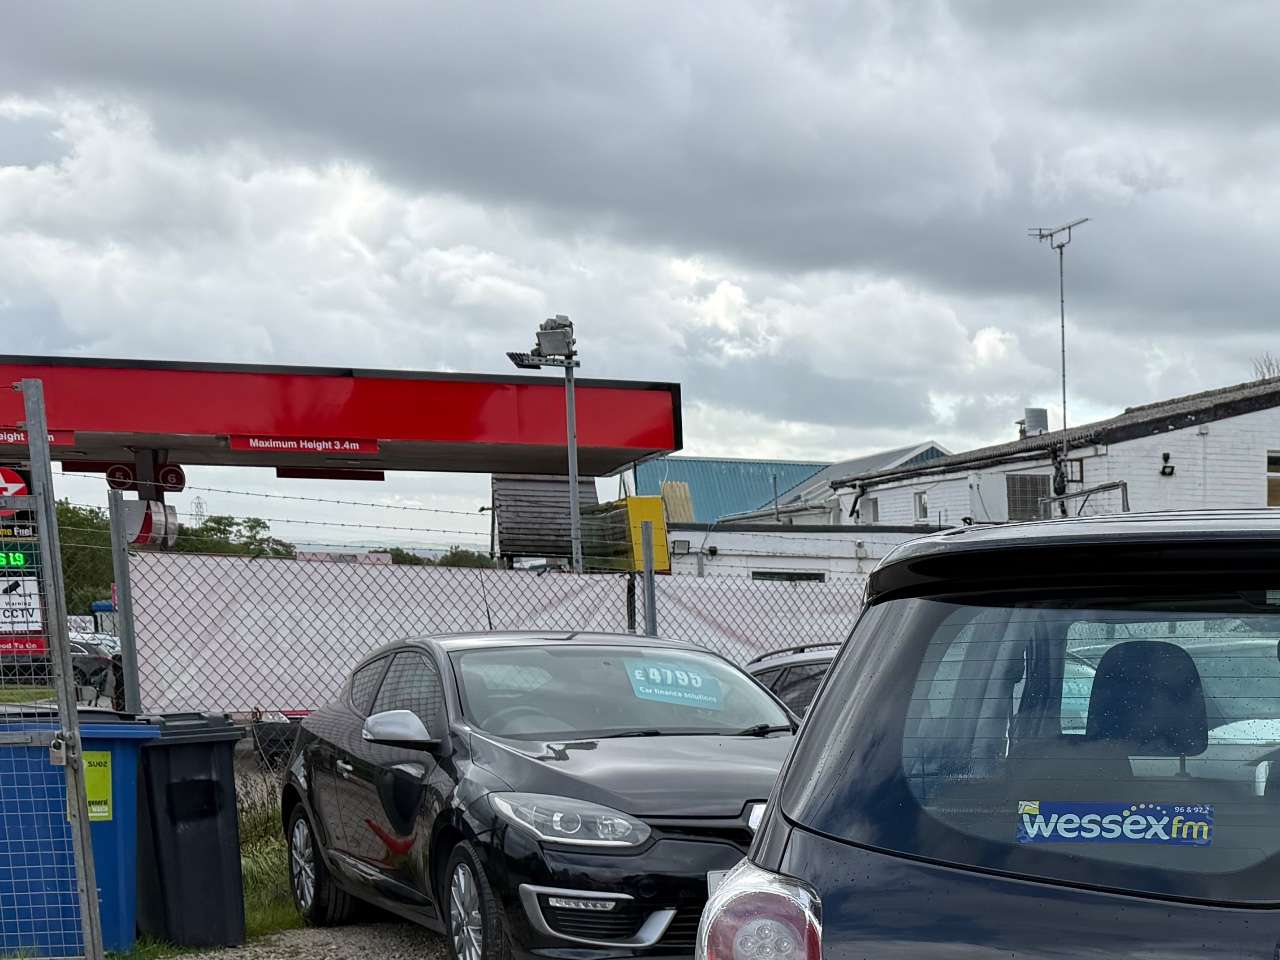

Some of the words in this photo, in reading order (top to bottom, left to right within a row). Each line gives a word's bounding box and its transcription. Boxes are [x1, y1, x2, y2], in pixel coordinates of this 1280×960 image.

[249, 438, 297, 449] Maximum
[300, 440, 332, 451] Height
[334, 441, 360, 450] 3.4m
[3, 608, 35, 618] CCTV
